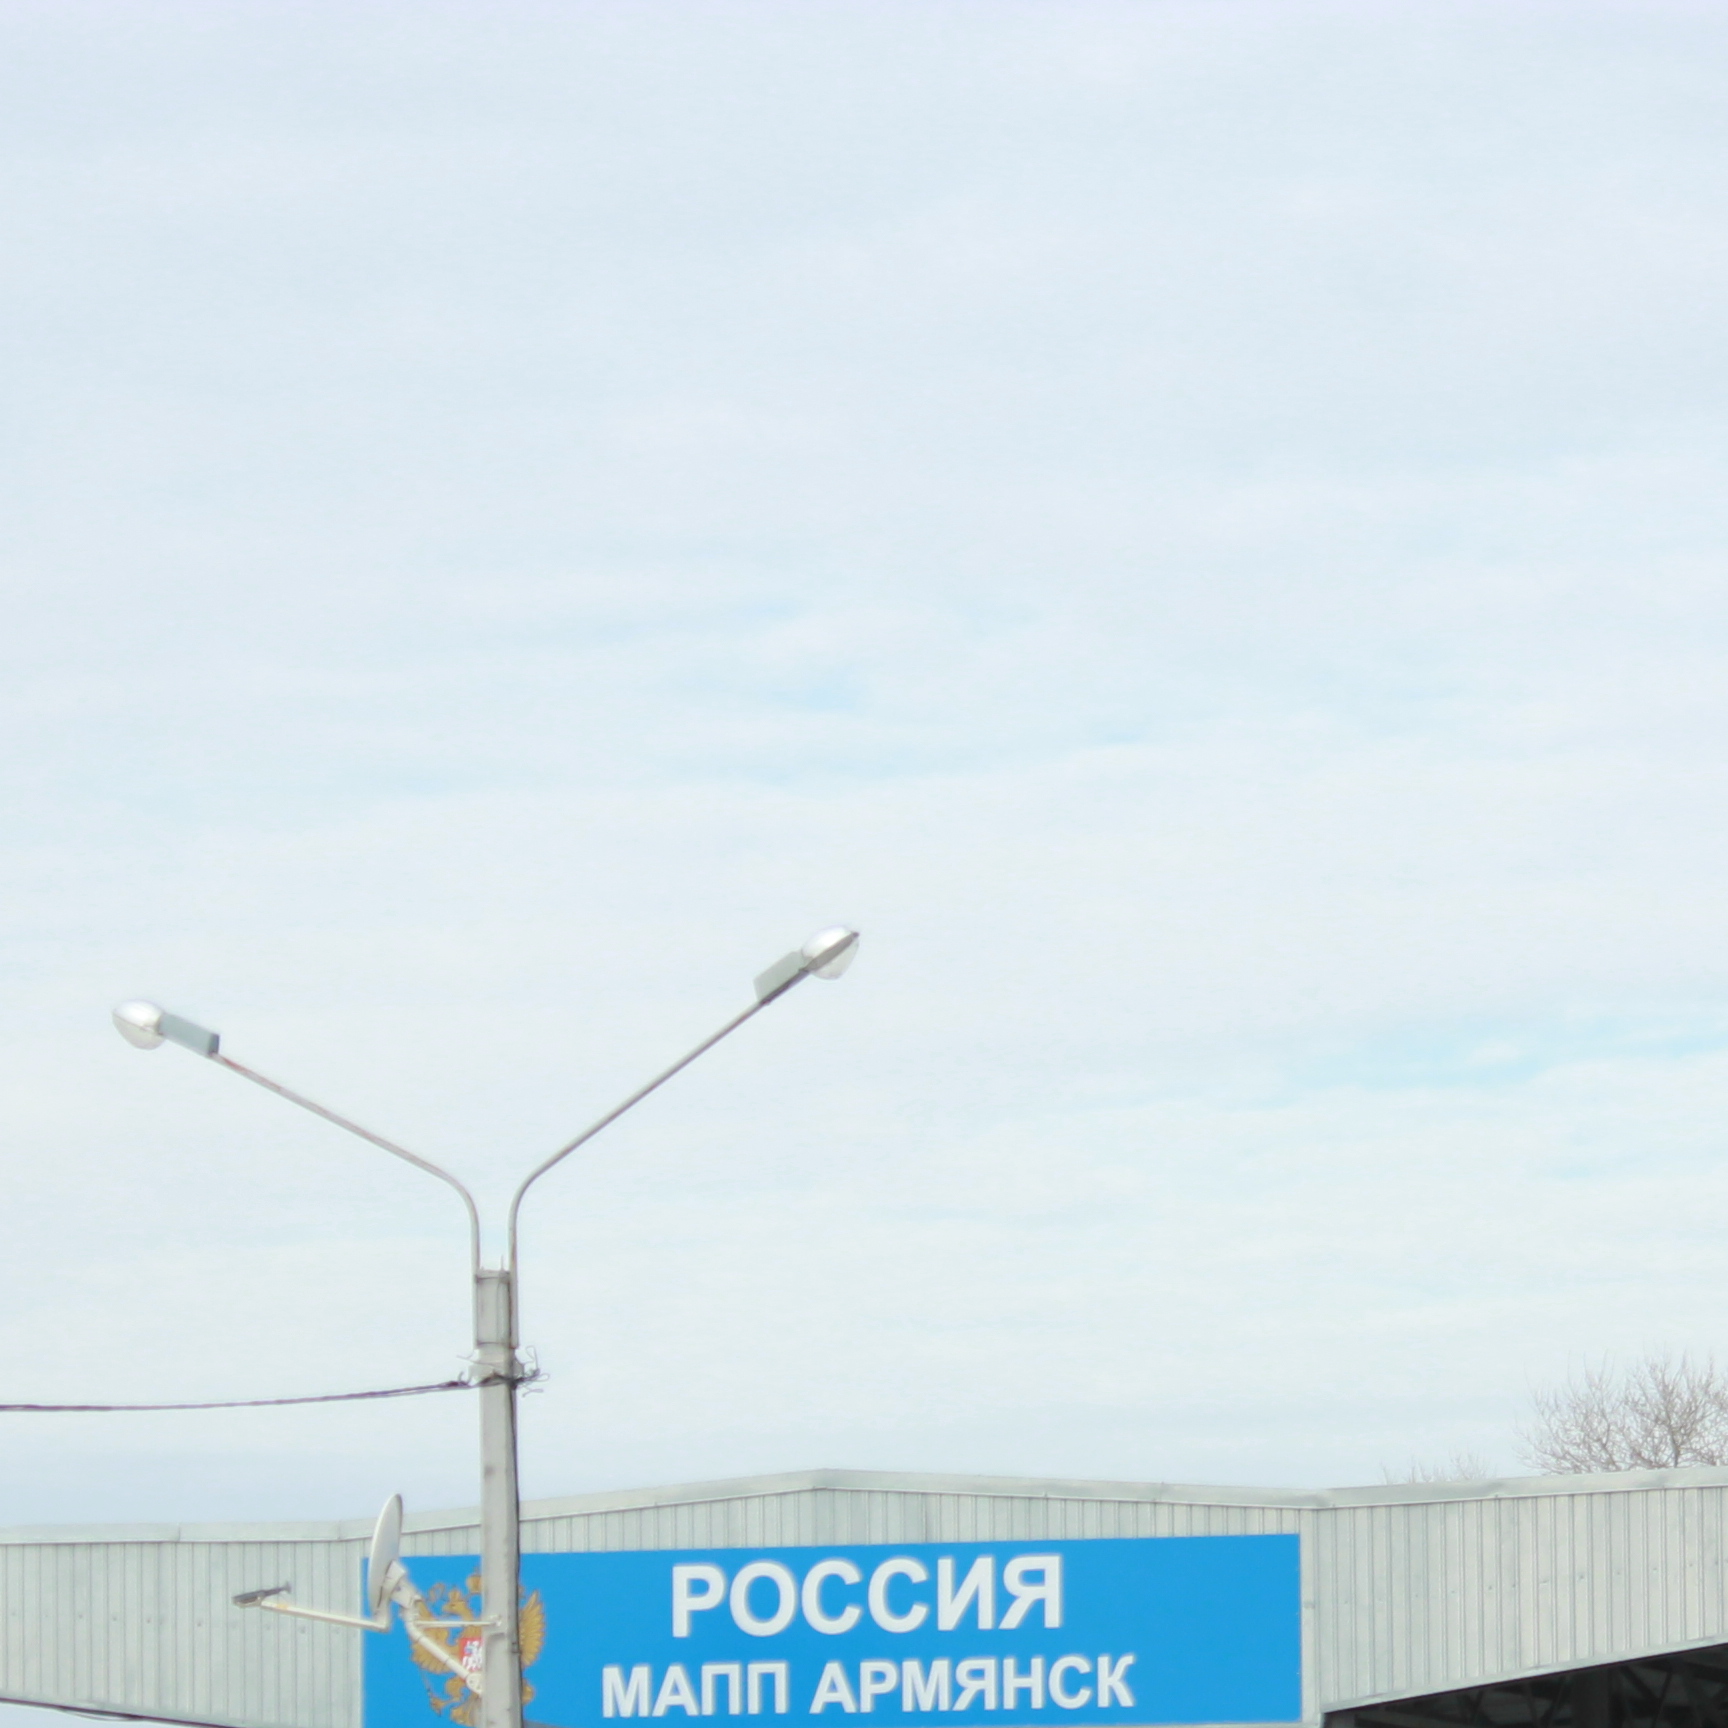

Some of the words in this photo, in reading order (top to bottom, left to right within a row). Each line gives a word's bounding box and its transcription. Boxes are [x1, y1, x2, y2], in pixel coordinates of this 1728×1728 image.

[672, 1553, 1063, 1638] РОССИЯ
[601, 1661, 787, 1718] МАПП
[809, 1653, 1136, 1714] АРМЯНСК
